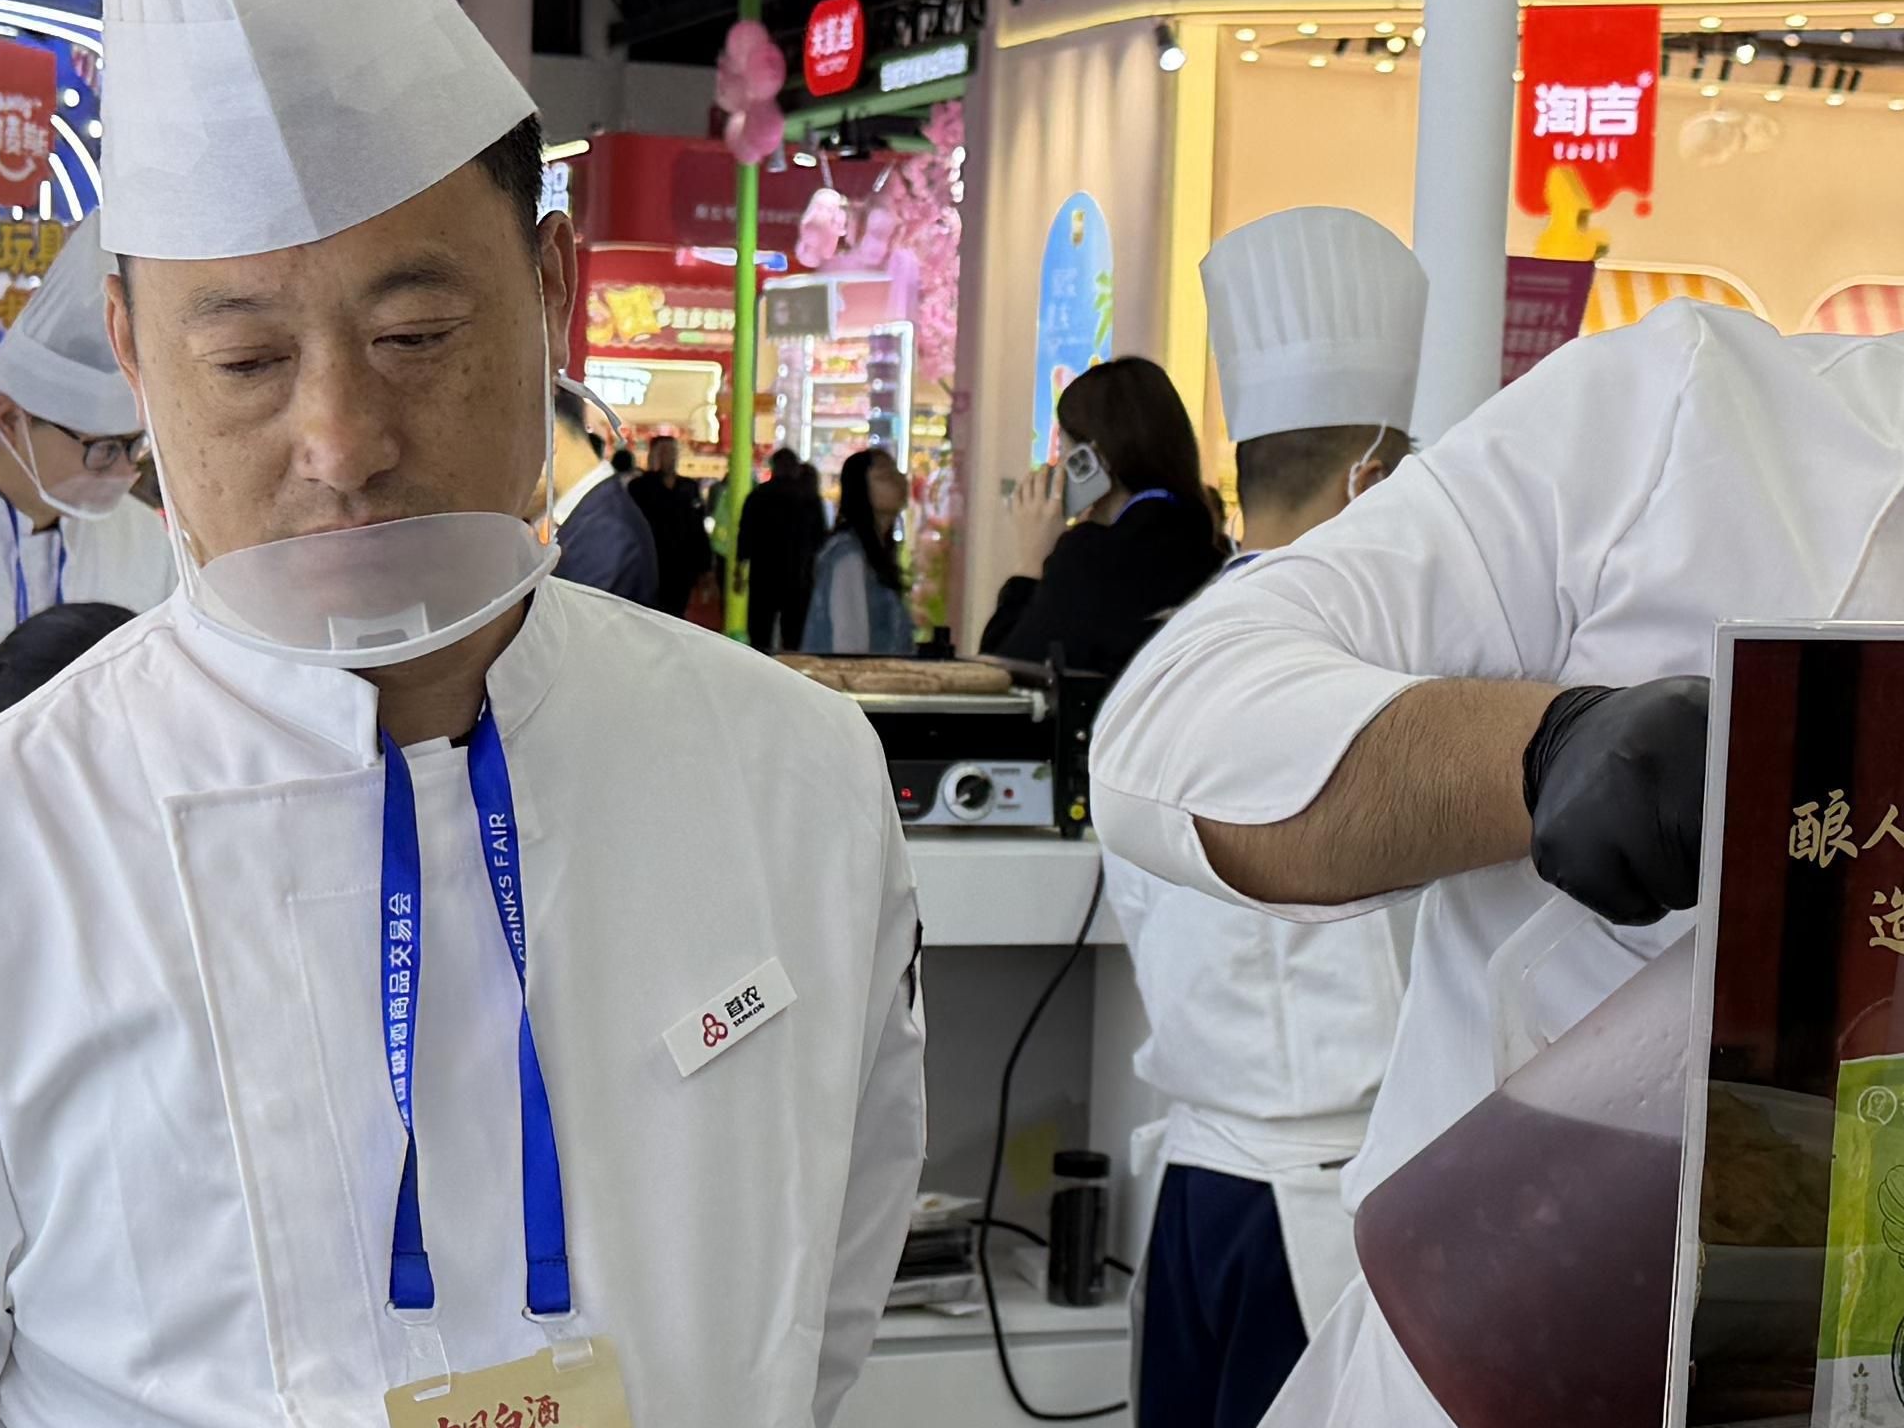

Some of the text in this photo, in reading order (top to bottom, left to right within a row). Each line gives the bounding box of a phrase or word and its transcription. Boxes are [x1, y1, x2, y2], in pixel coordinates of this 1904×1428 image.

[1534, 82, 1643, 137] 淘吉
[488, 812, 508, 868] FAIR
[724, 985, 763, 1019] 首农
